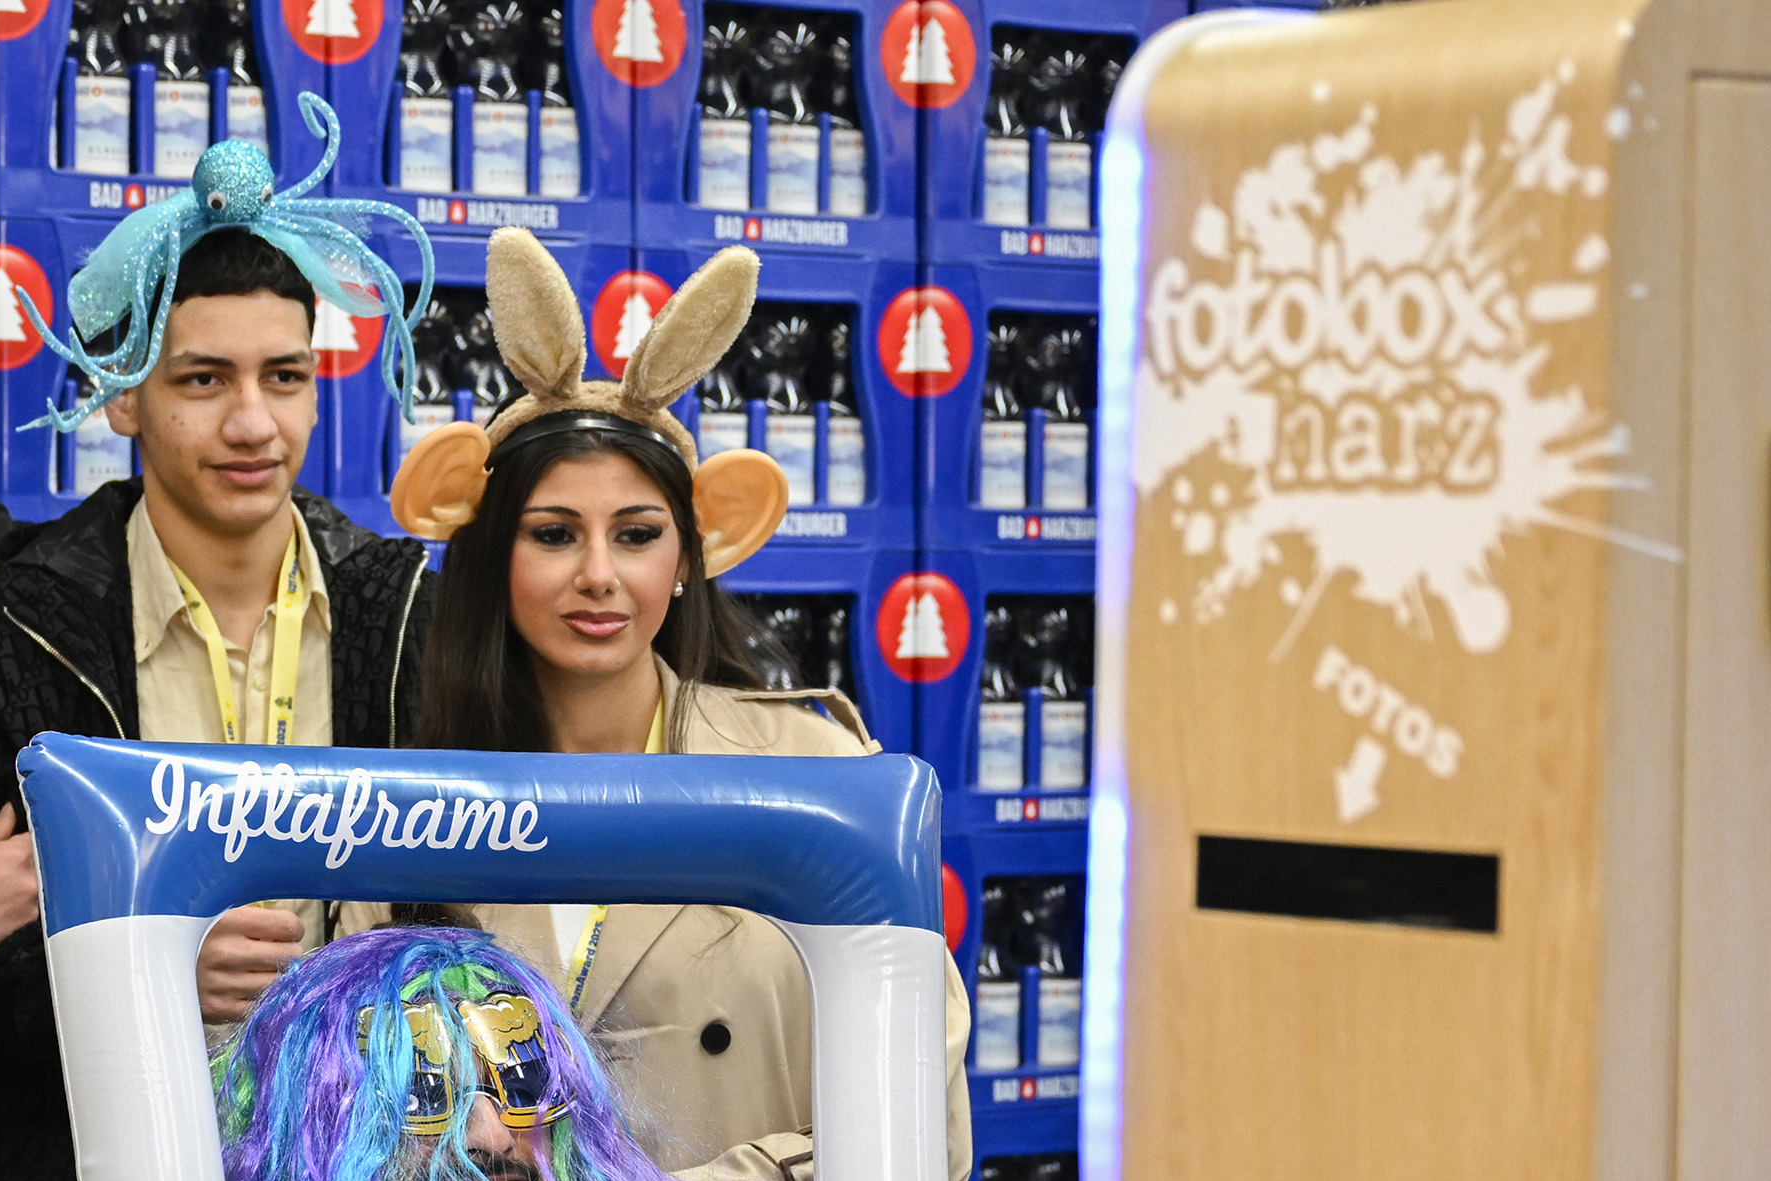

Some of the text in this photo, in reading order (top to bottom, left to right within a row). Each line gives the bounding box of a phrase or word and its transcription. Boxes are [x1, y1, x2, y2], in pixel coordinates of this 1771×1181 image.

[90, 181, 123, 208] BAD
[1147, 237, 1510, 372] fotobox
[1312, 645, 1464, 778] FOTOS
[145, 757, 548, 869] Inflaframe
